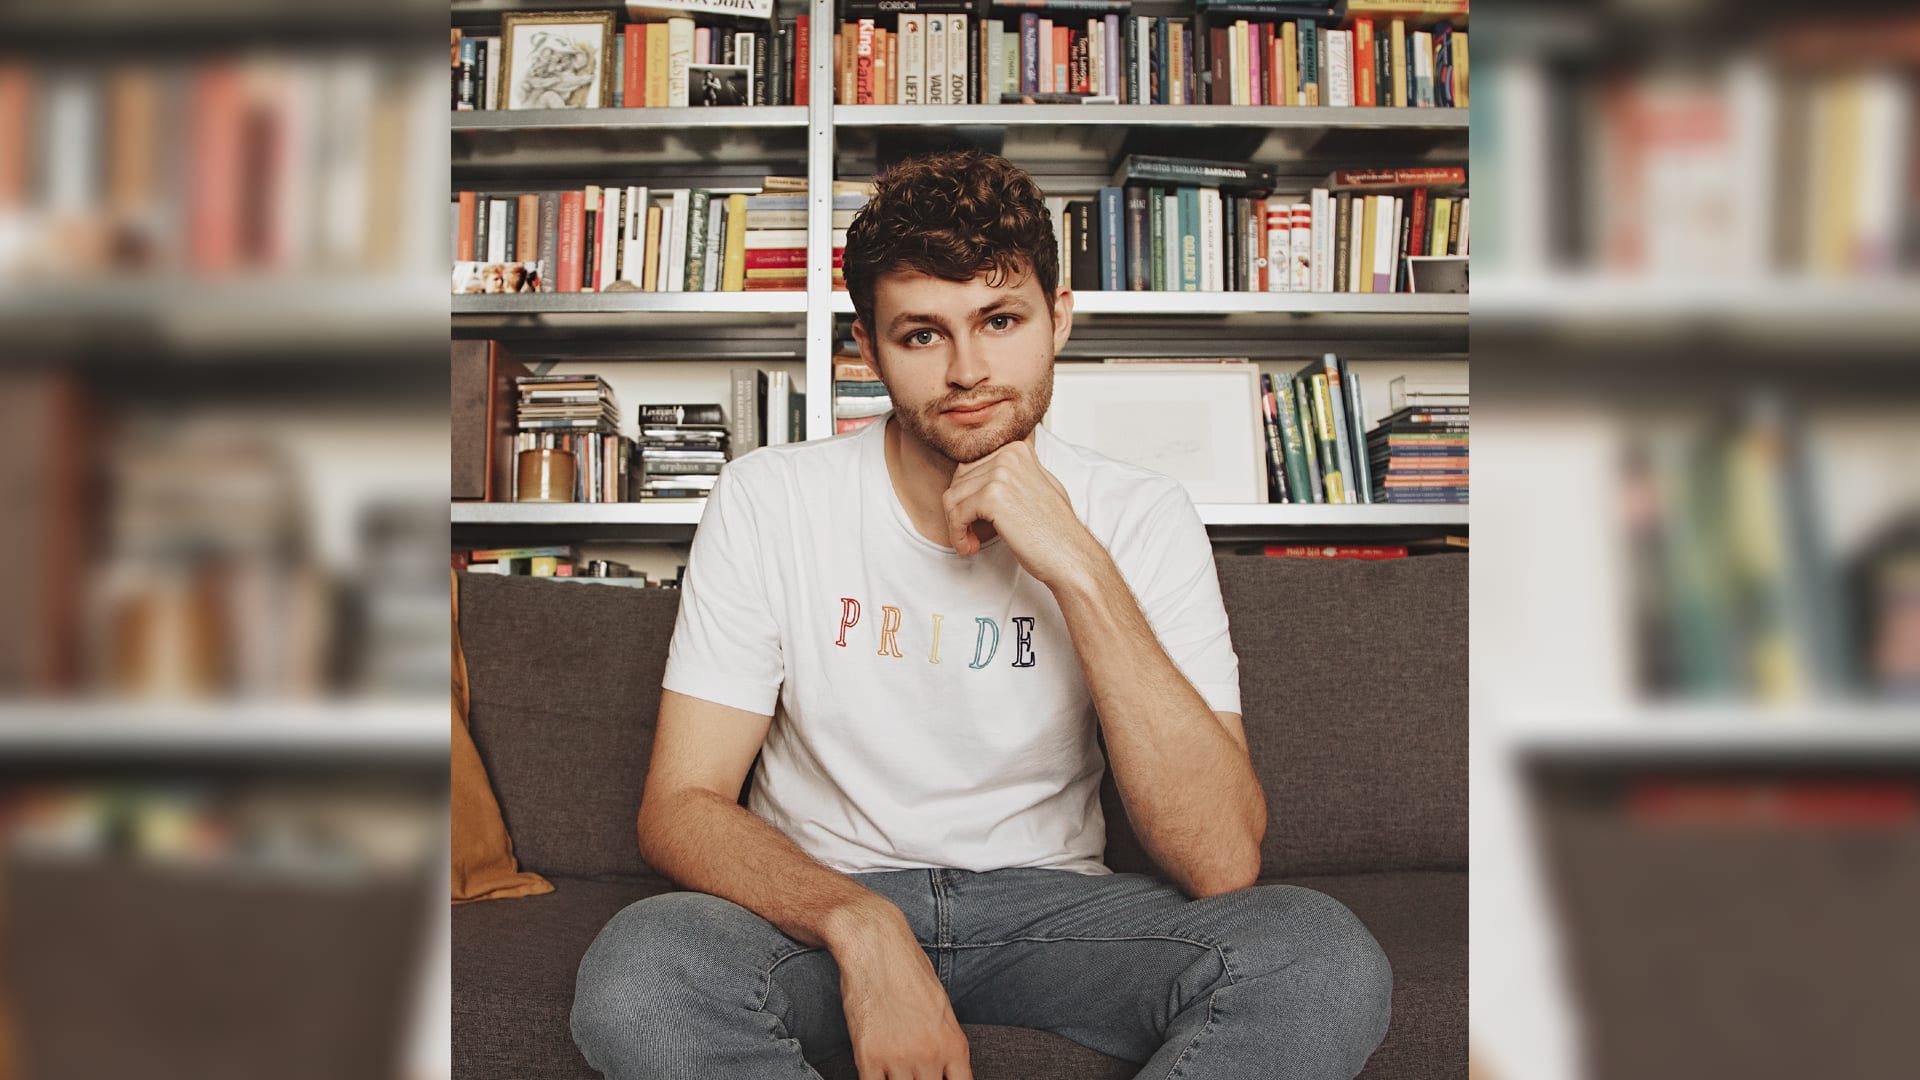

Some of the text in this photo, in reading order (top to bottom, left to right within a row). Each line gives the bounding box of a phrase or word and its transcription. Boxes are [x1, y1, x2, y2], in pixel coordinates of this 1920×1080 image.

[1079, 37, 1089, 55] Tom
[857, 19, 874, 105] King Carrie
[1204, 167, 1247, 179] BARRACUDA
[659, 462, 700, 473] orphans
[836, 597, 1036, 670] PRIDE
